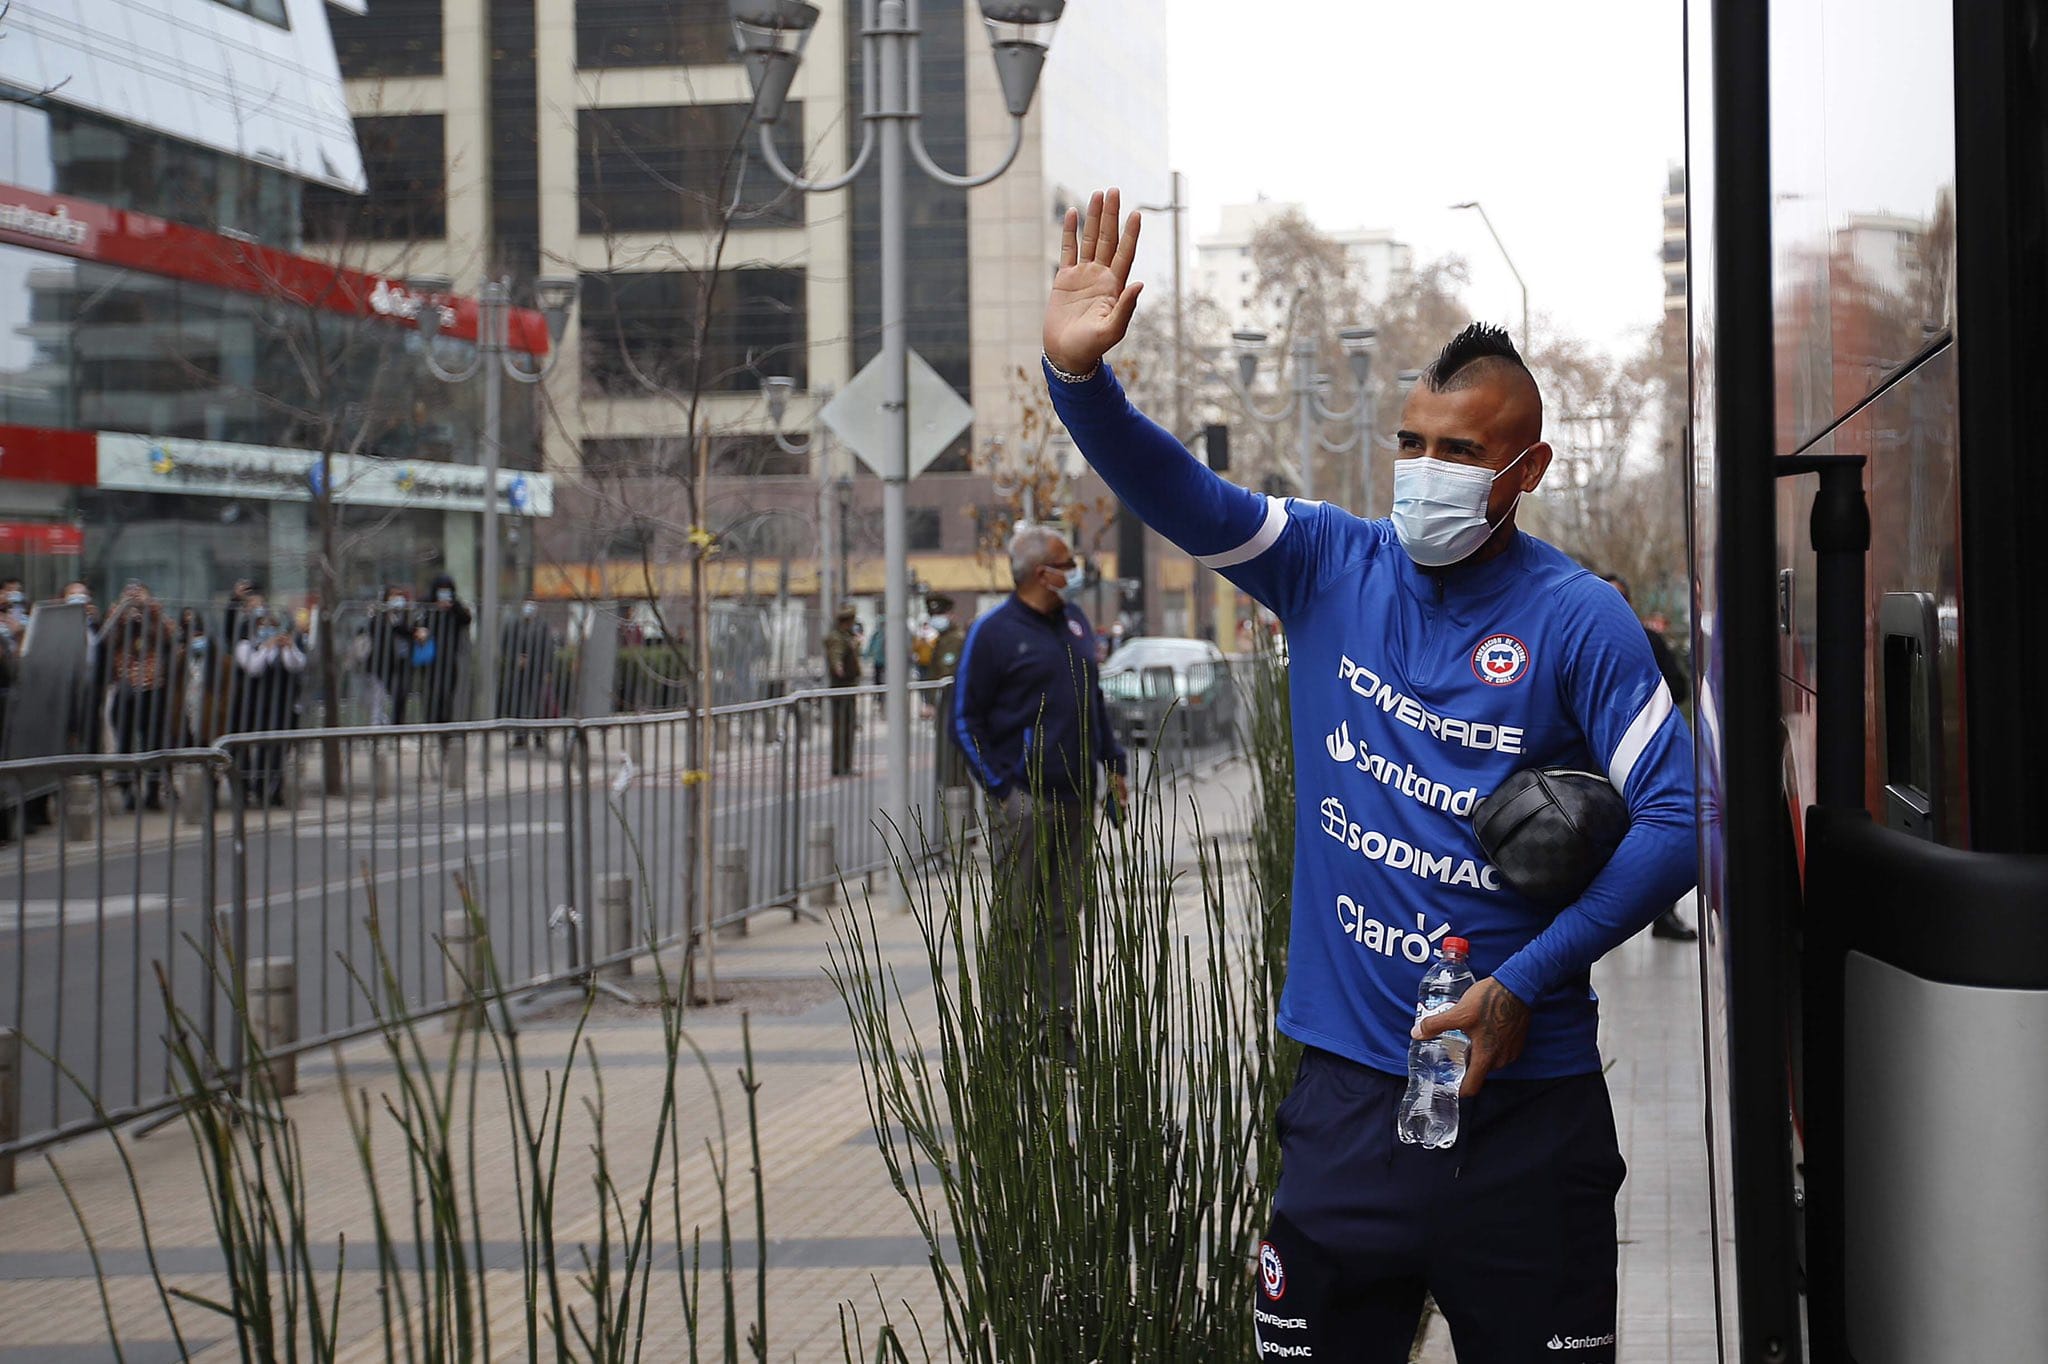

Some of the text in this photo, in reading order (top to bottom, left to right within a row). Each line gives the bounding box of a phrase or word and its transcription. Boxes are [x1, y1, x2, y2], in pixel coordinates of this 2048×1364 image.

[1338, 654, 1524, 755] POWERADE
[1355, 739, 1488, 817] Santand
[1347, 822, 1501, 891] SODIMAC
[1336, 894, 1430, 964] Claro
